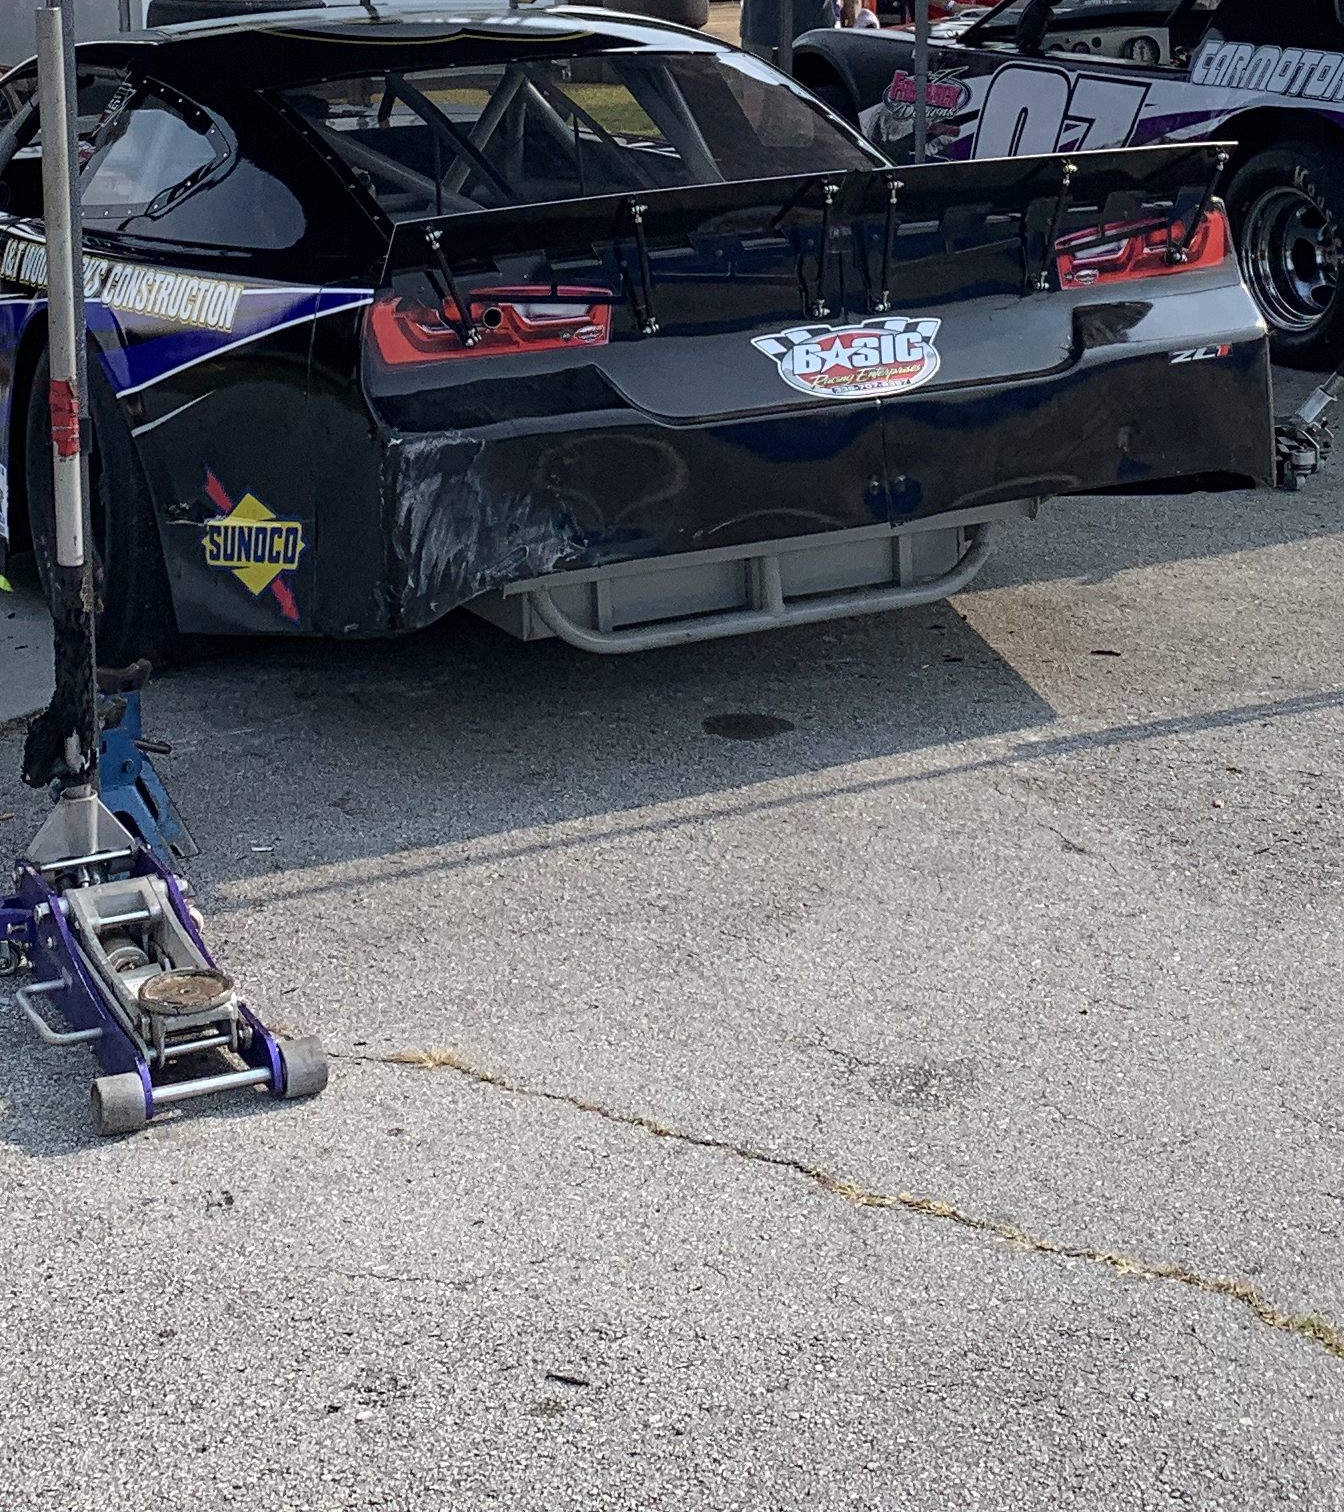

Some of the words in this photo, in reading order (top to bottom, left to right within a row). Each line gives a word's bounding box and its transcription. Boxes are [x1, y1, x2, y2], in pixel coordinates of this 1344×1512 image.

[102, 263, 244, 333] CONSTRUCTION
[793, 332, 924, 375] BASIC
[208, 525, 299, 564] SUNOCO
